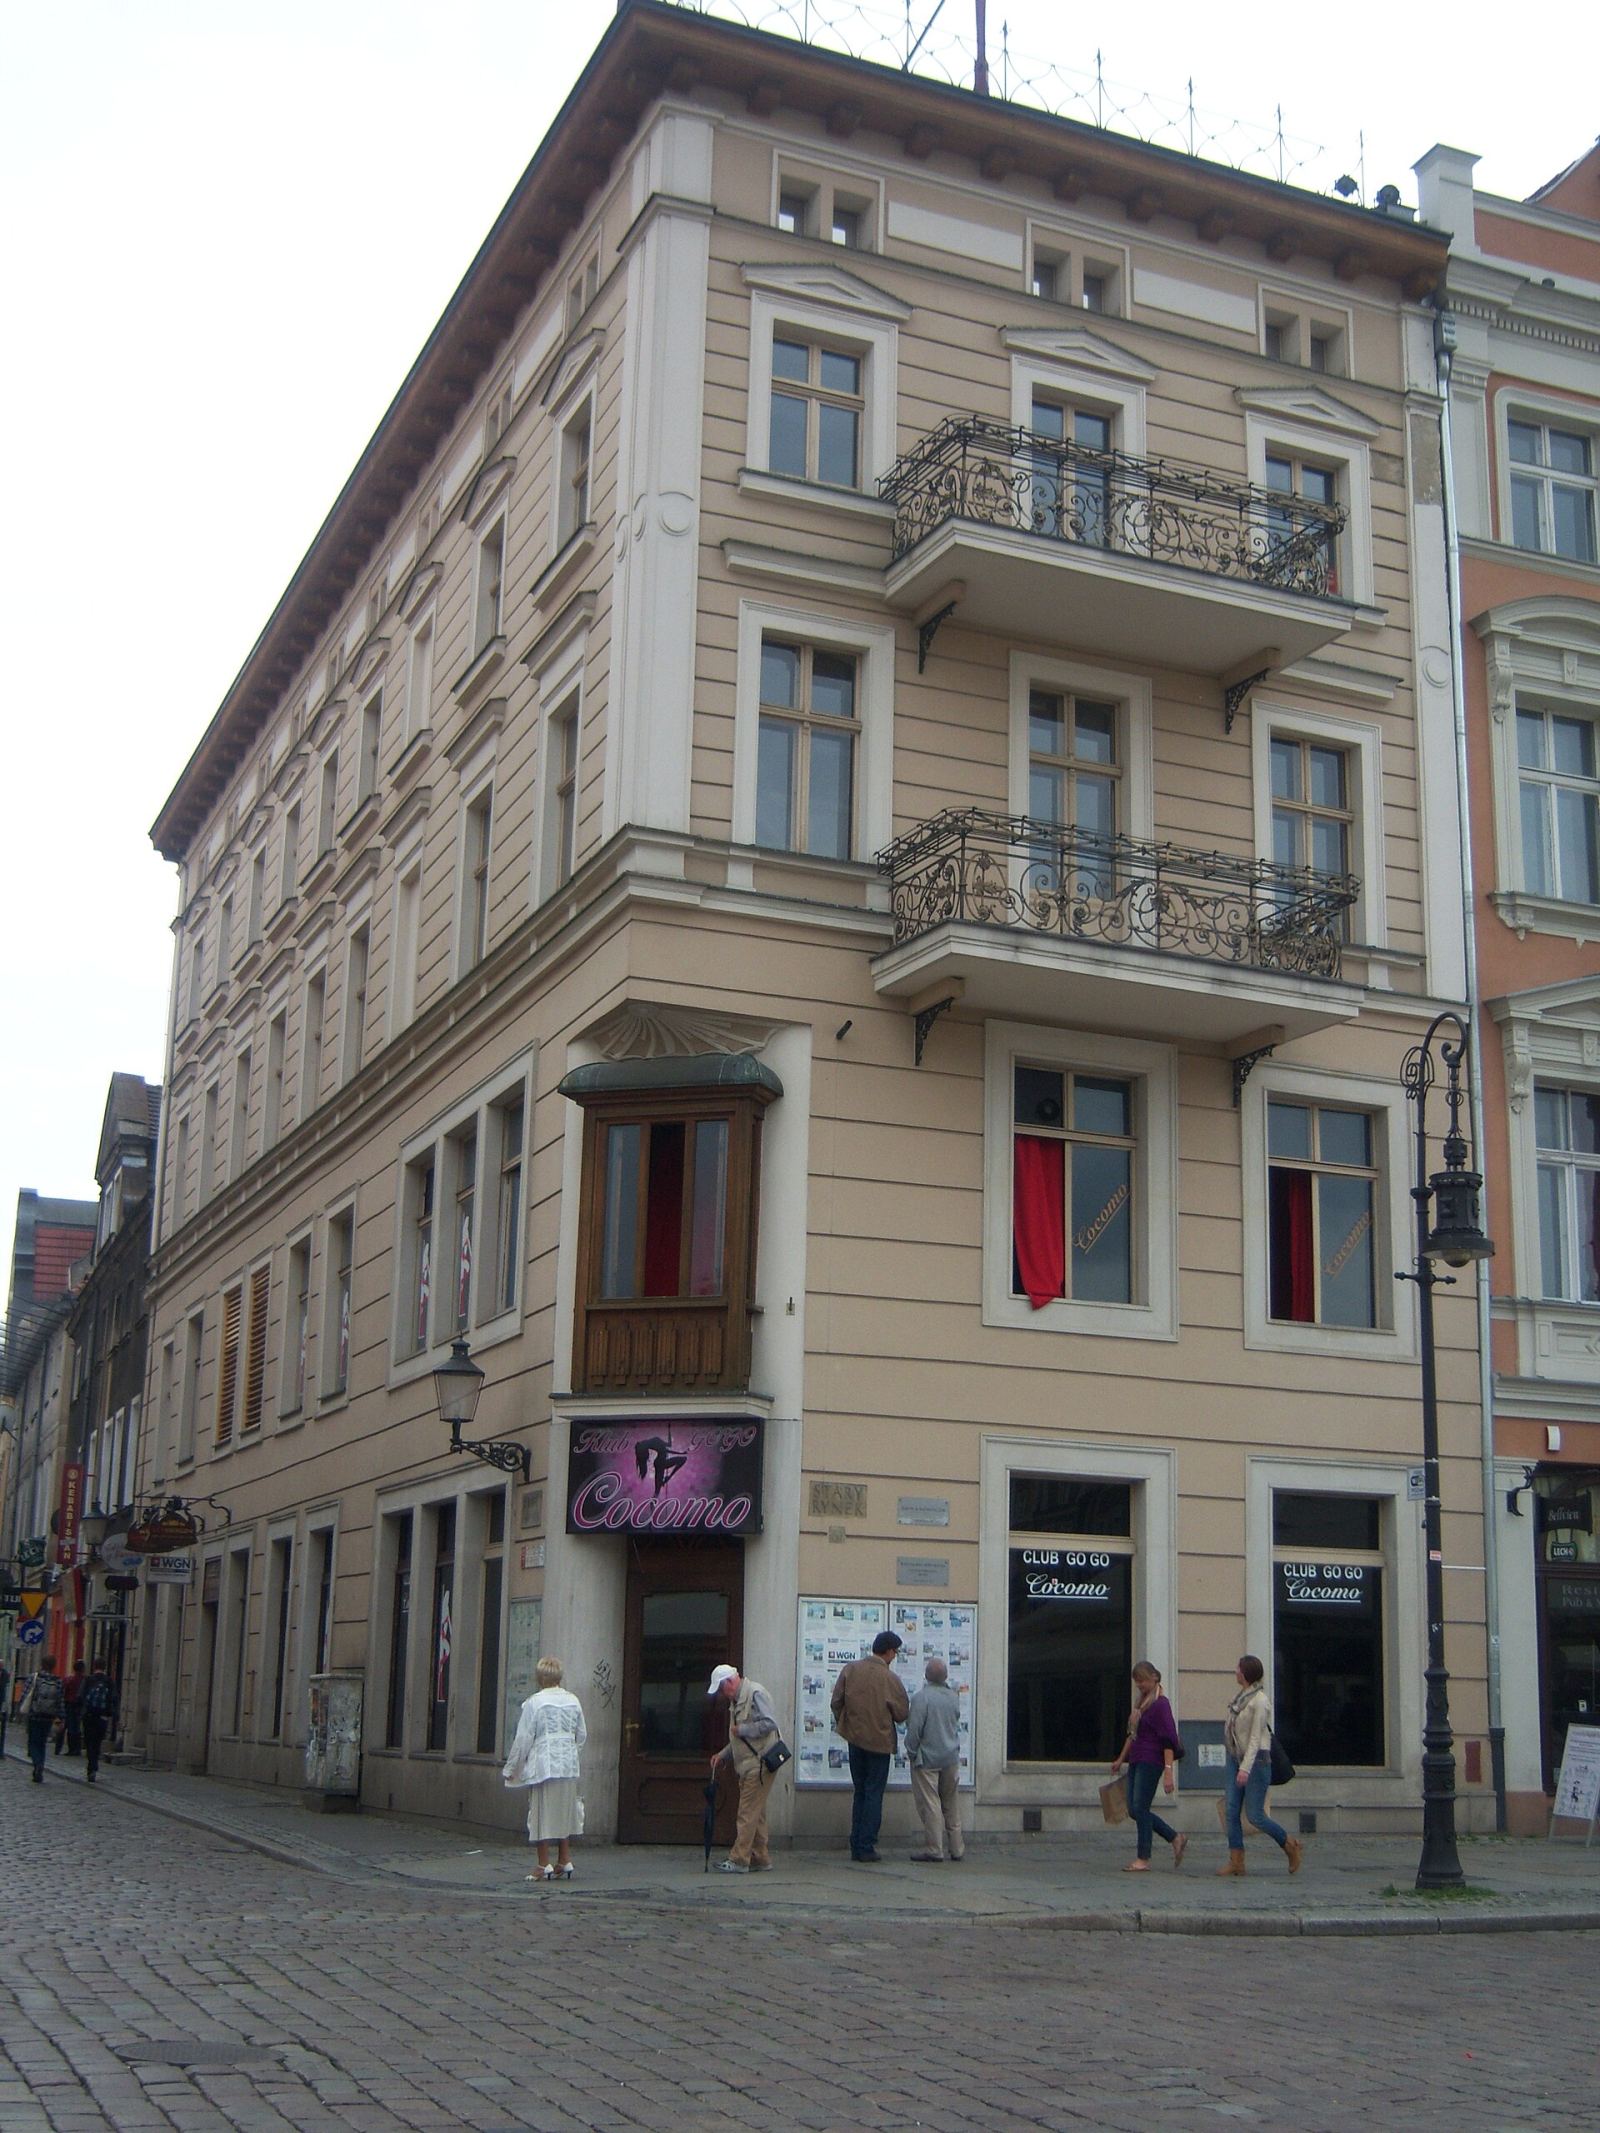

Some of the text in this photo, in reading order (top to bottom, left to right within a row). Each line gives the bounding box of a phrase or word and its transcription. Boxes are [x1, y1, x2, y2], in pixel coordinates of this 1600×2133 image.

[1072, 1182, 1130, 1250] Cocomo
[573, 1428, 630, 1454] Klub
[573, 1471, 751, 1529] Cocomo
[813, 1484, 864, 1500] STARY
[812, 1500, 864, 1517] RYNEK
[162, 1557, 191, 1569] WGN
[1023, 1550, 1110, 1567] CLUB GO GO
[1283, 1563, 1363, 1580] CLUB GO GO
[1025, 1572, 1111, 1596] Cocomo
[1285, 1577, 1363, 1600] Cocomo
[836, 1650, 856, 1660] WGN
